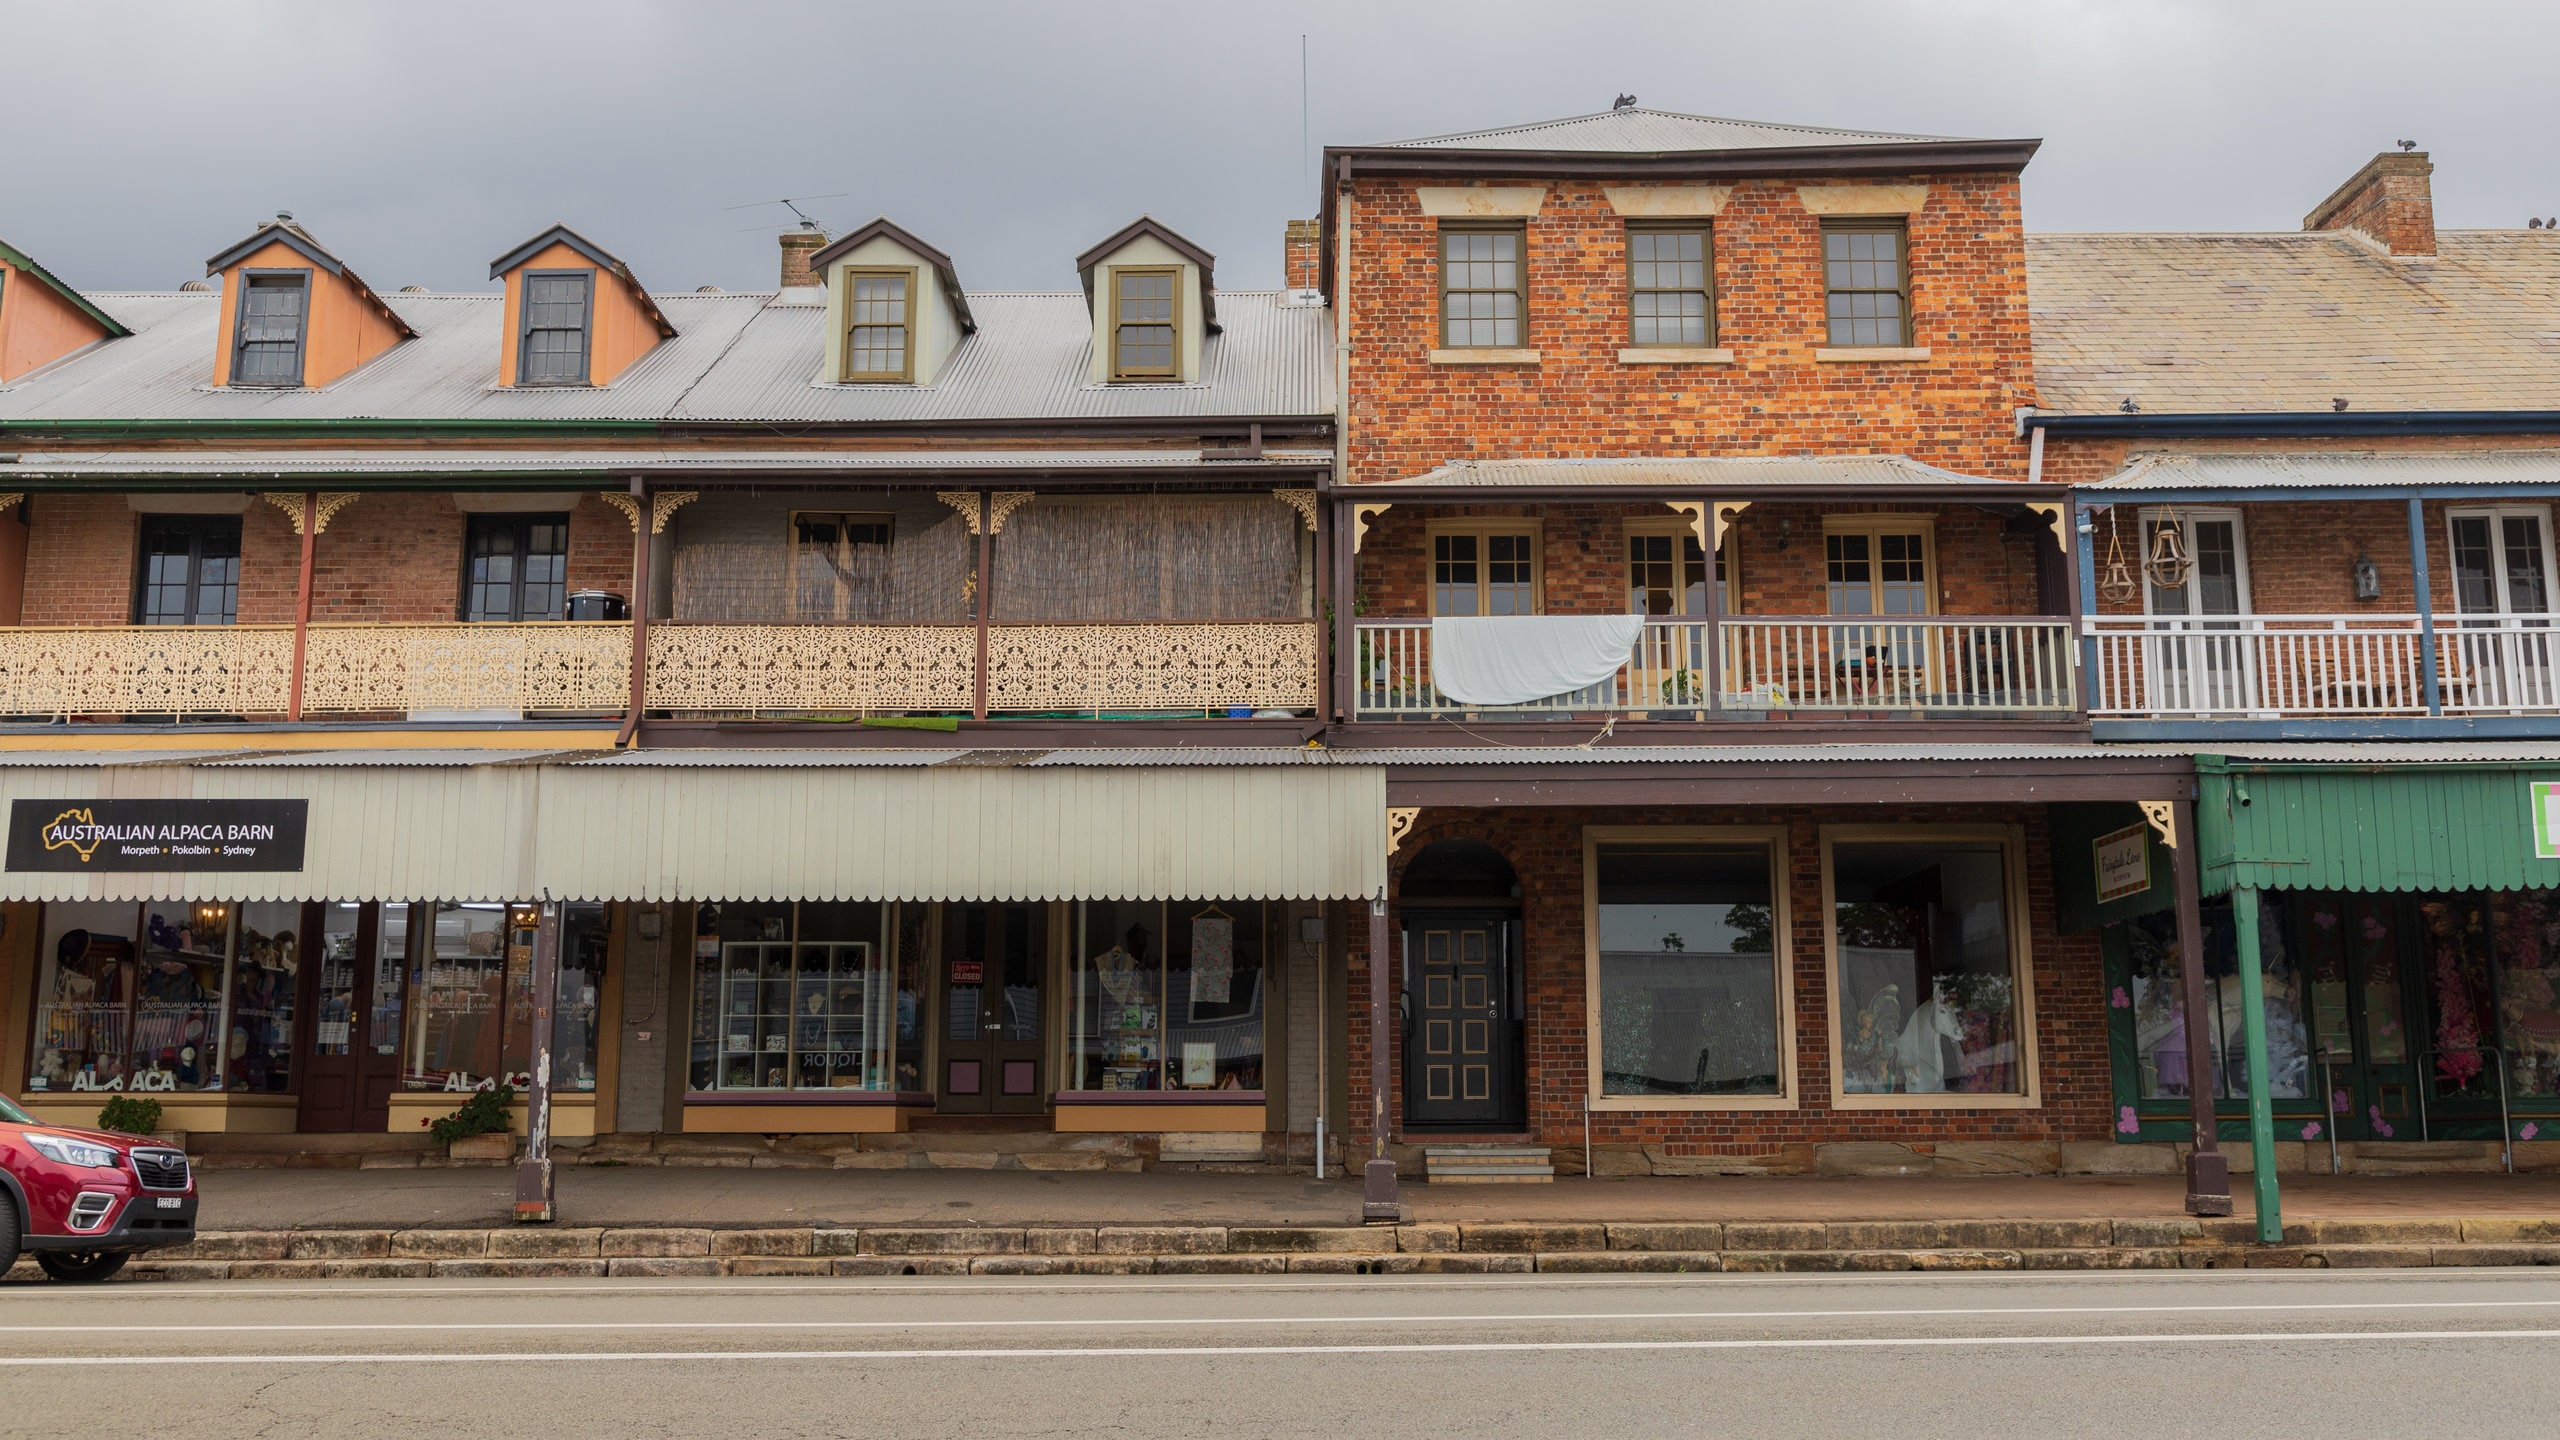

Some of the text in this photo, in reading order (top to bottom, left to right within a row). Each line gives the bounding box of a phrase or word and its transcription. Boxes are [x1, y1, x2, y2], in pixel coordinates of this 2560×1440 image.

[50, 825, 274, 840] AUSTRALIAN ALPACA BARN
[121, 845, 256, 857] Morpeth Pokolbin Sydney
[84, 1001, 108, 1009] ALPACA
[109, 1001, 127, 1009] BARN
[144, 1001, 182, 1009] AUSTRALIAN
[183, 1001, 207, 1009] ALPACA
